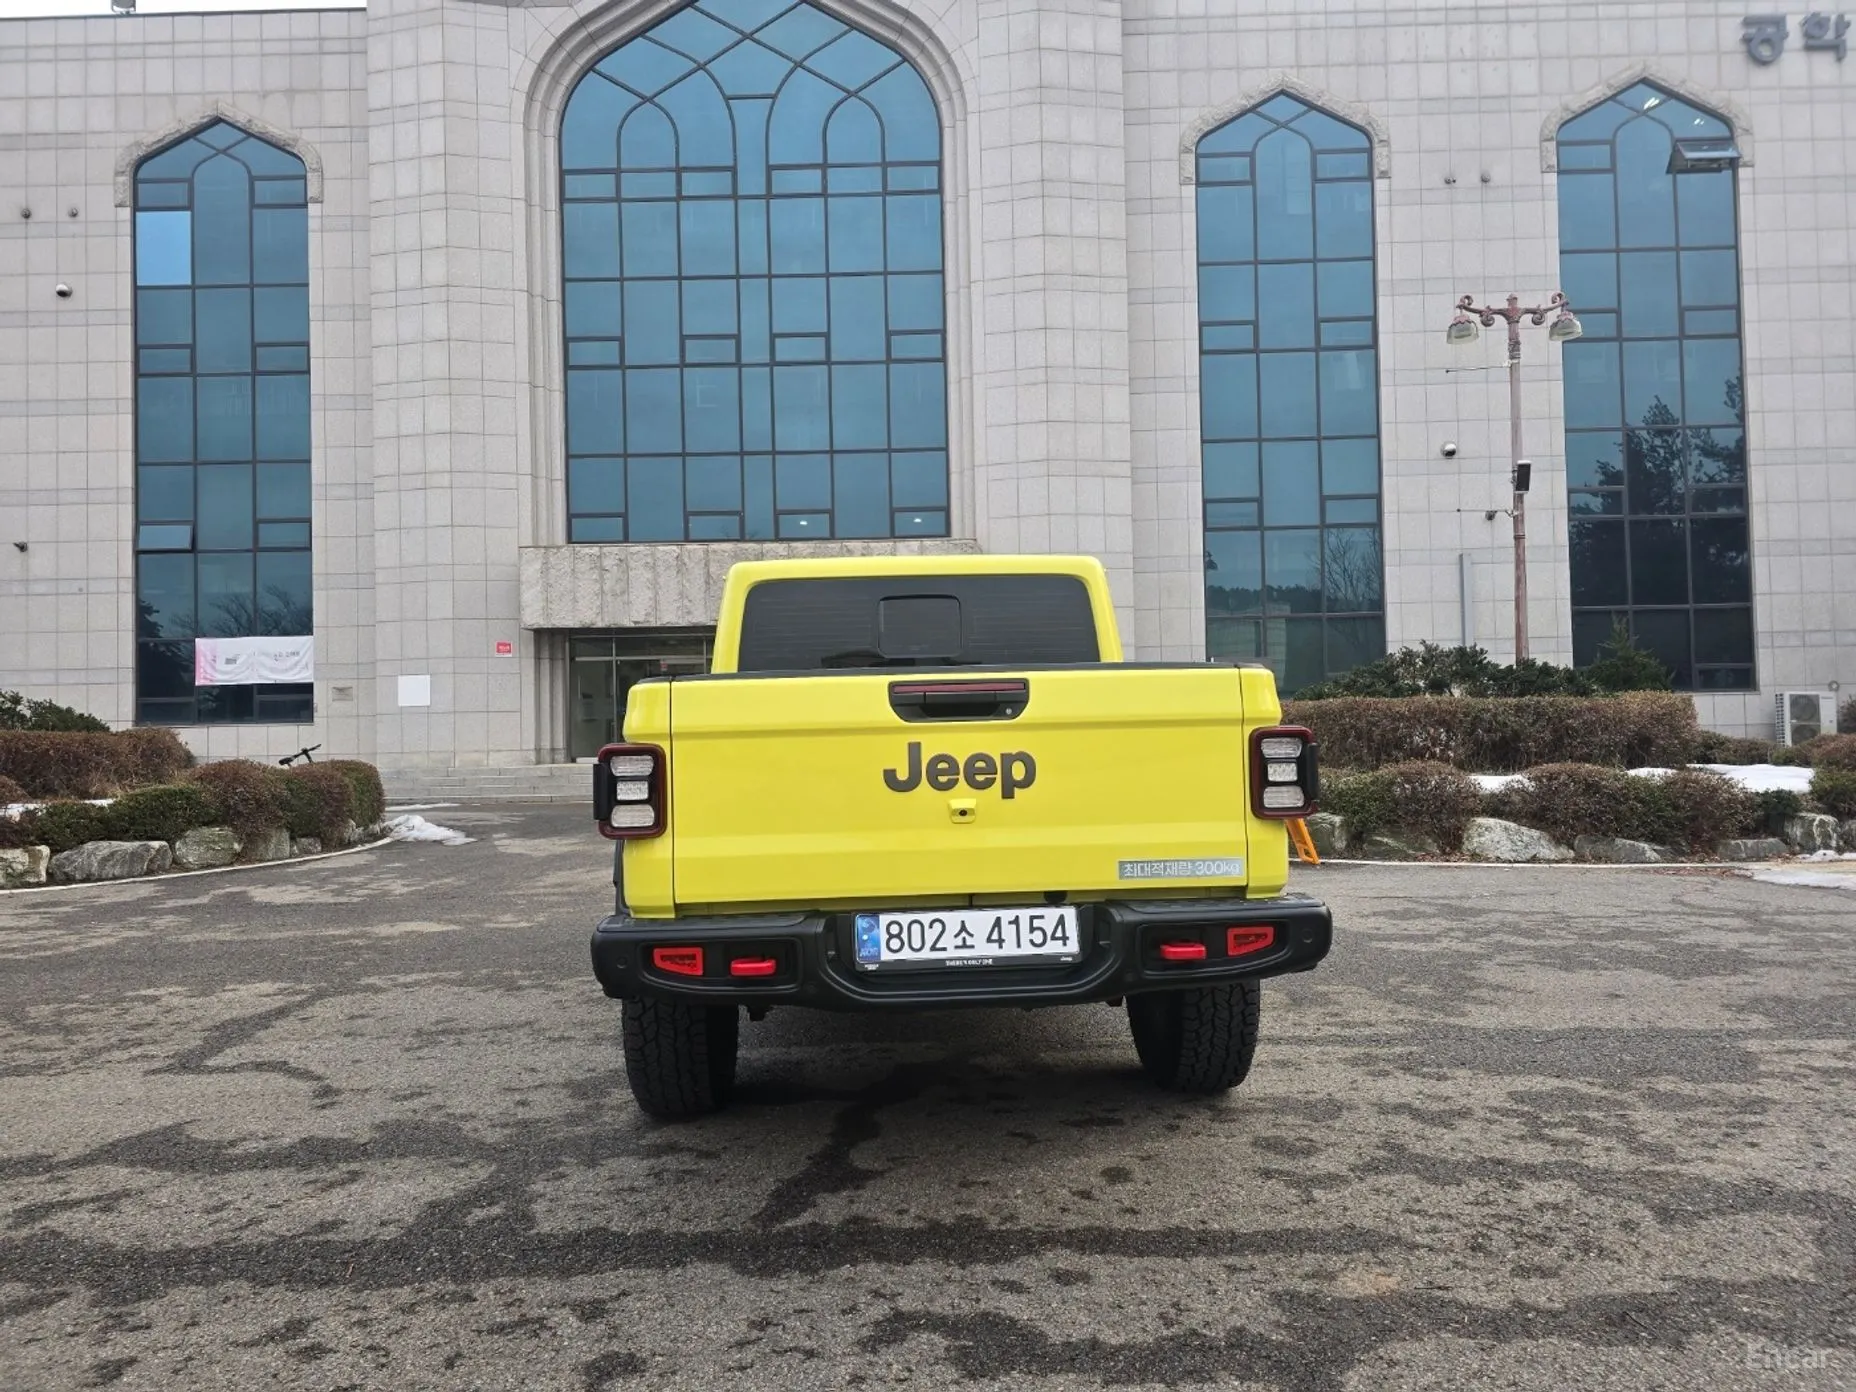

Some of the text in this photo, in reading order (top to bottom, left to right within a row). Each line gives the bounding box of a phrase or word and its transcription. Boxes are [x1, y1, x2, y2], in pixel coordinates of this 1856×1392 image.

[883, 741, 1036, 799] Jeep
[1124, 860, 1240, 877] 최대적재량 300kg
[885, 914, 1069, 953] 802소 4154
